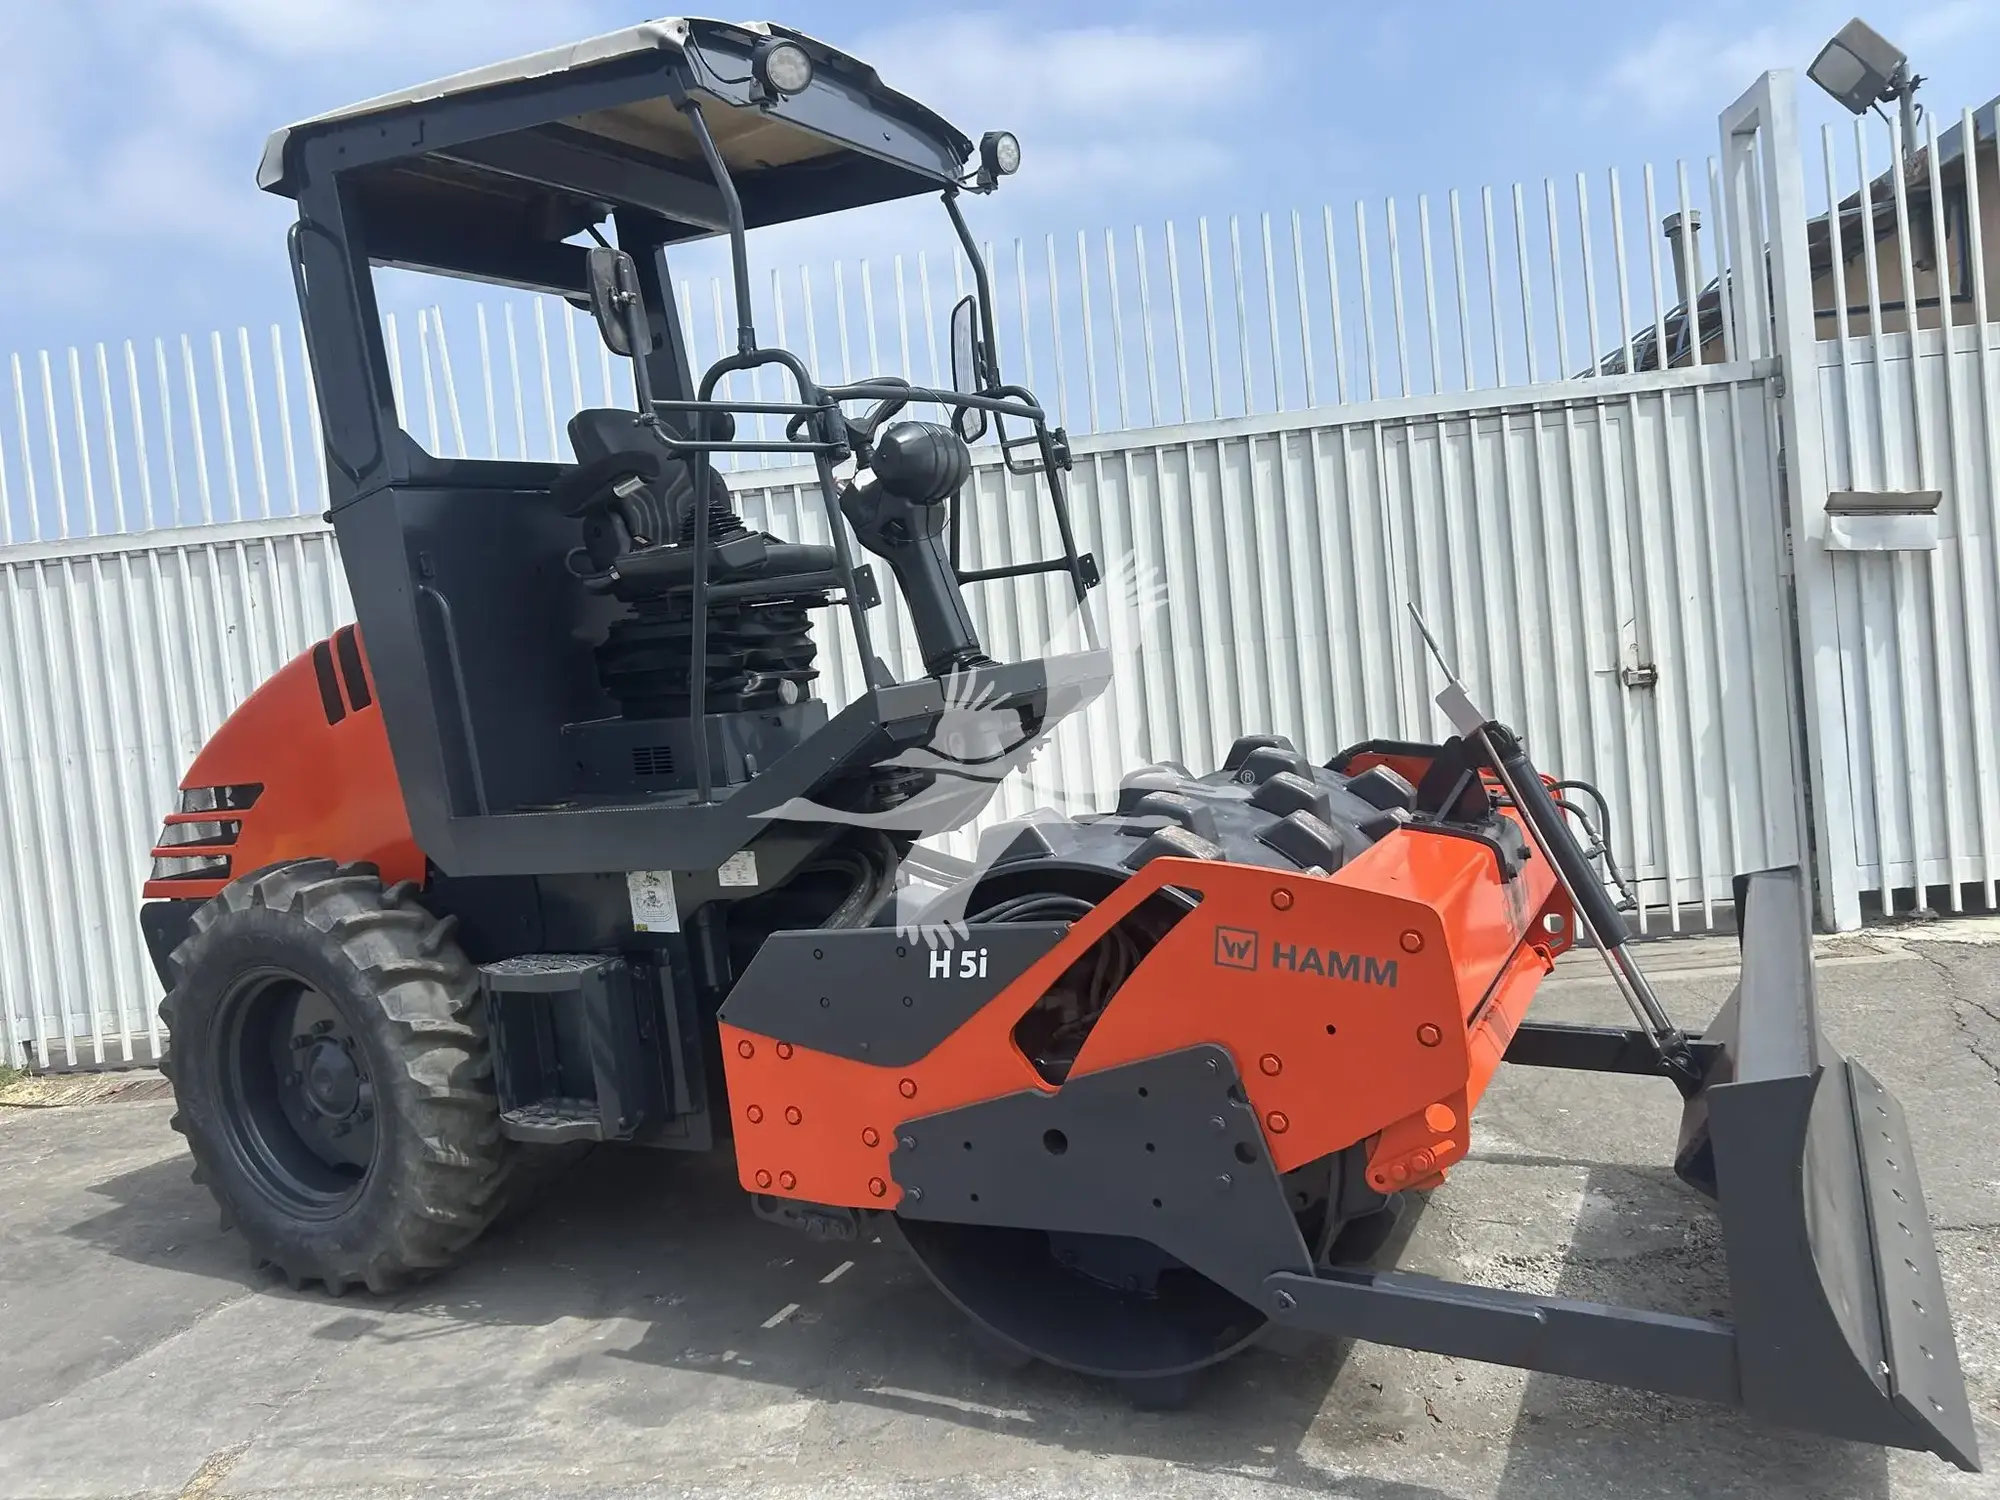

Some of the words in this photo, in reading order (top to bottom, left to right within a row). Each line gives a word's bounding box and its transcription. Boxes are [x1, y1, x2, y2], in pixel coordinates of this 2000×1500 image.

[929, 949, 951, 979] H
[959, 947, 988, 979] 5i
[1272, 941, 1398, 988] HAMM
